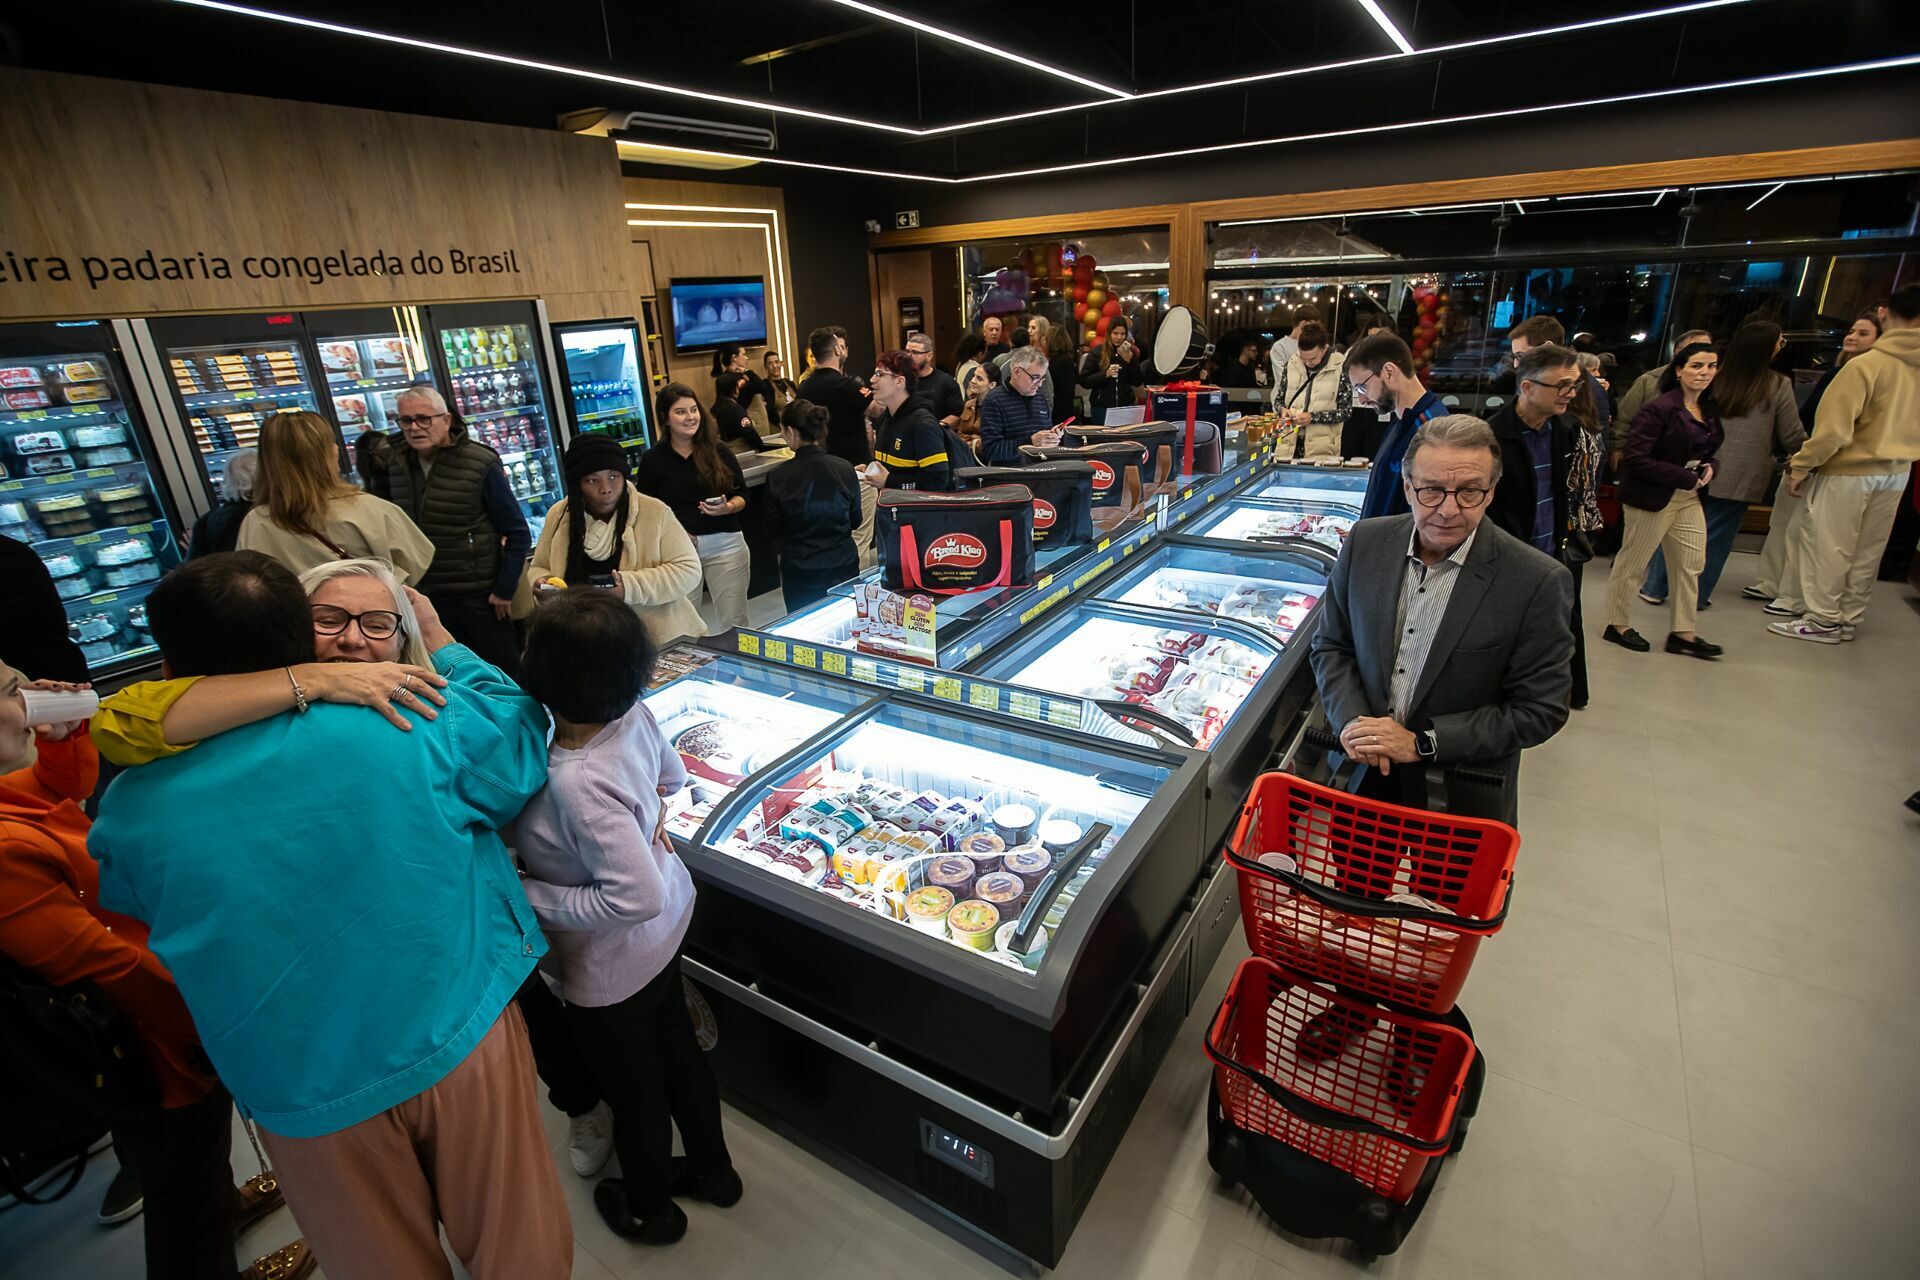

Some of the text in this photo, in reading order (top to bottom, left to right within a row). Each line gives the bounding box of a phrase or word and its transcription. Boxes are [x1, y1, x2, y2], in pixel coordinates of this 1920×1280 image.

[81, 249, 231, 290] padaria
[241, 248, 402, 286] congelada
[410, 250, 445, 276] do
[450, 249, 521, 275] Brasil
[1034, 508, 1053, 520] King
[930, 544, 982, 562] Bread King
[909, 615, 931, 625] GLUTEN
[908, 625, 932, 635] LACTOSE
